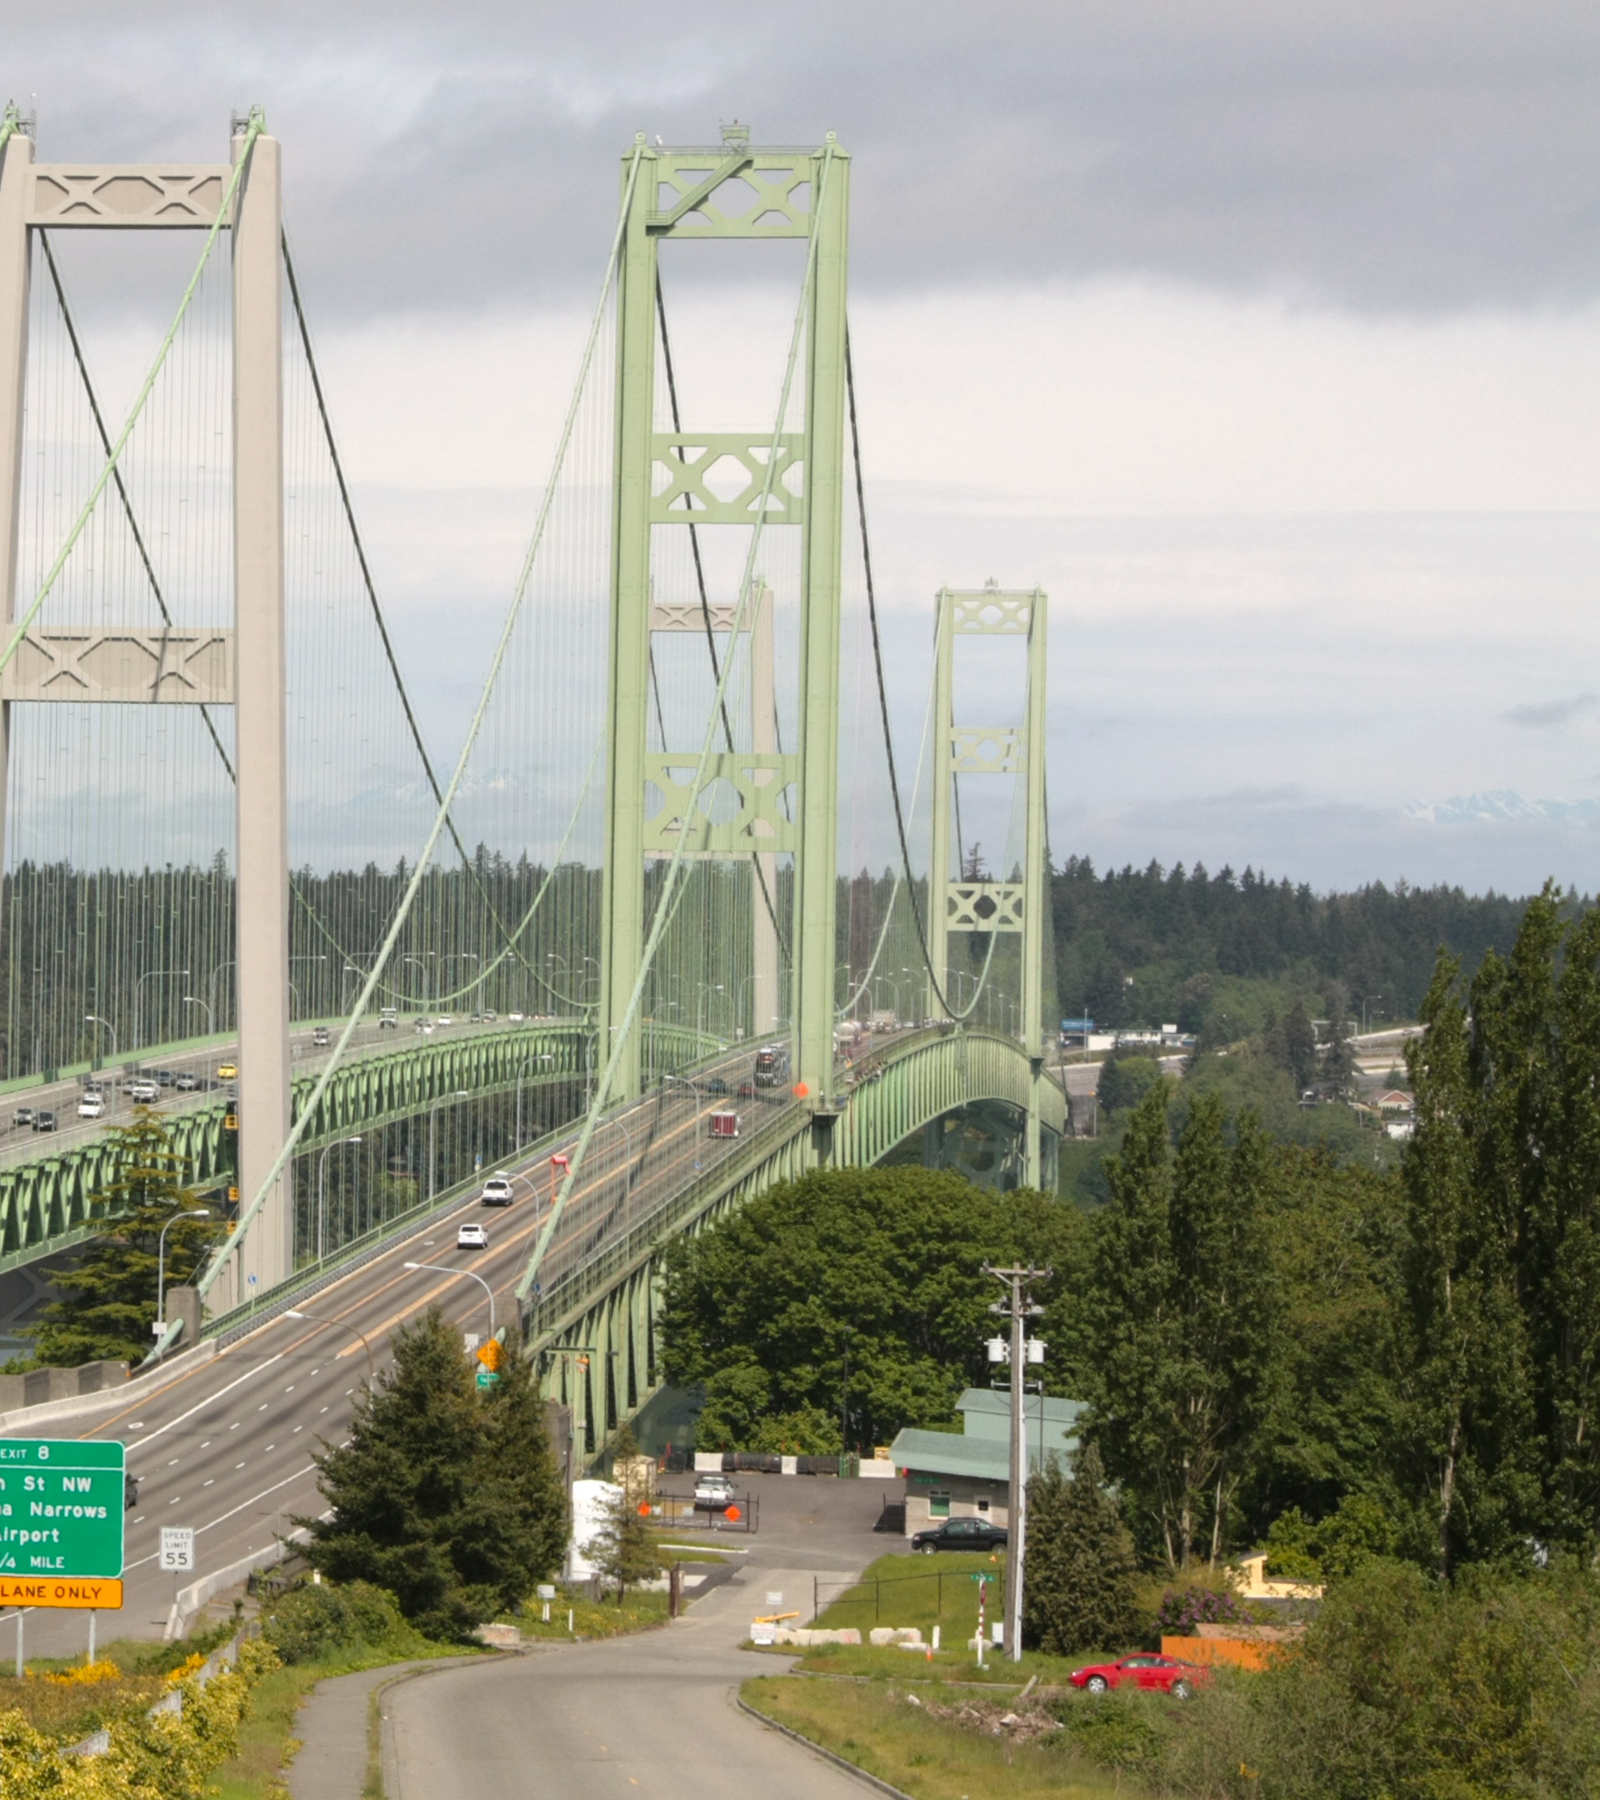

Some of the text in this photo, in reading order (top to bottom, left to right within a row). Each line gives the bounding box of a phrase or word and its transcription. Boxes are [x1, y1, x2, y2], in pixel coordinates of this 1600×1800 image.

[0, 1446, 50, 1460] EXIT 8
[23, 1475, 45, 1492] St
[62, 1476, 92, 1493] NW
[30, 1501, 108, 1519] Narrows
[163, 1531, 191, 1539] SPEED
[165, 1541, 188, 1549] LIMIT
[30, 1555, 65, 1570] MILE
[165, 1552, 188, 1566] 55
[0, 1585, 47, 1599] LANE
[55, 1586, 102, 1600] ONLY
